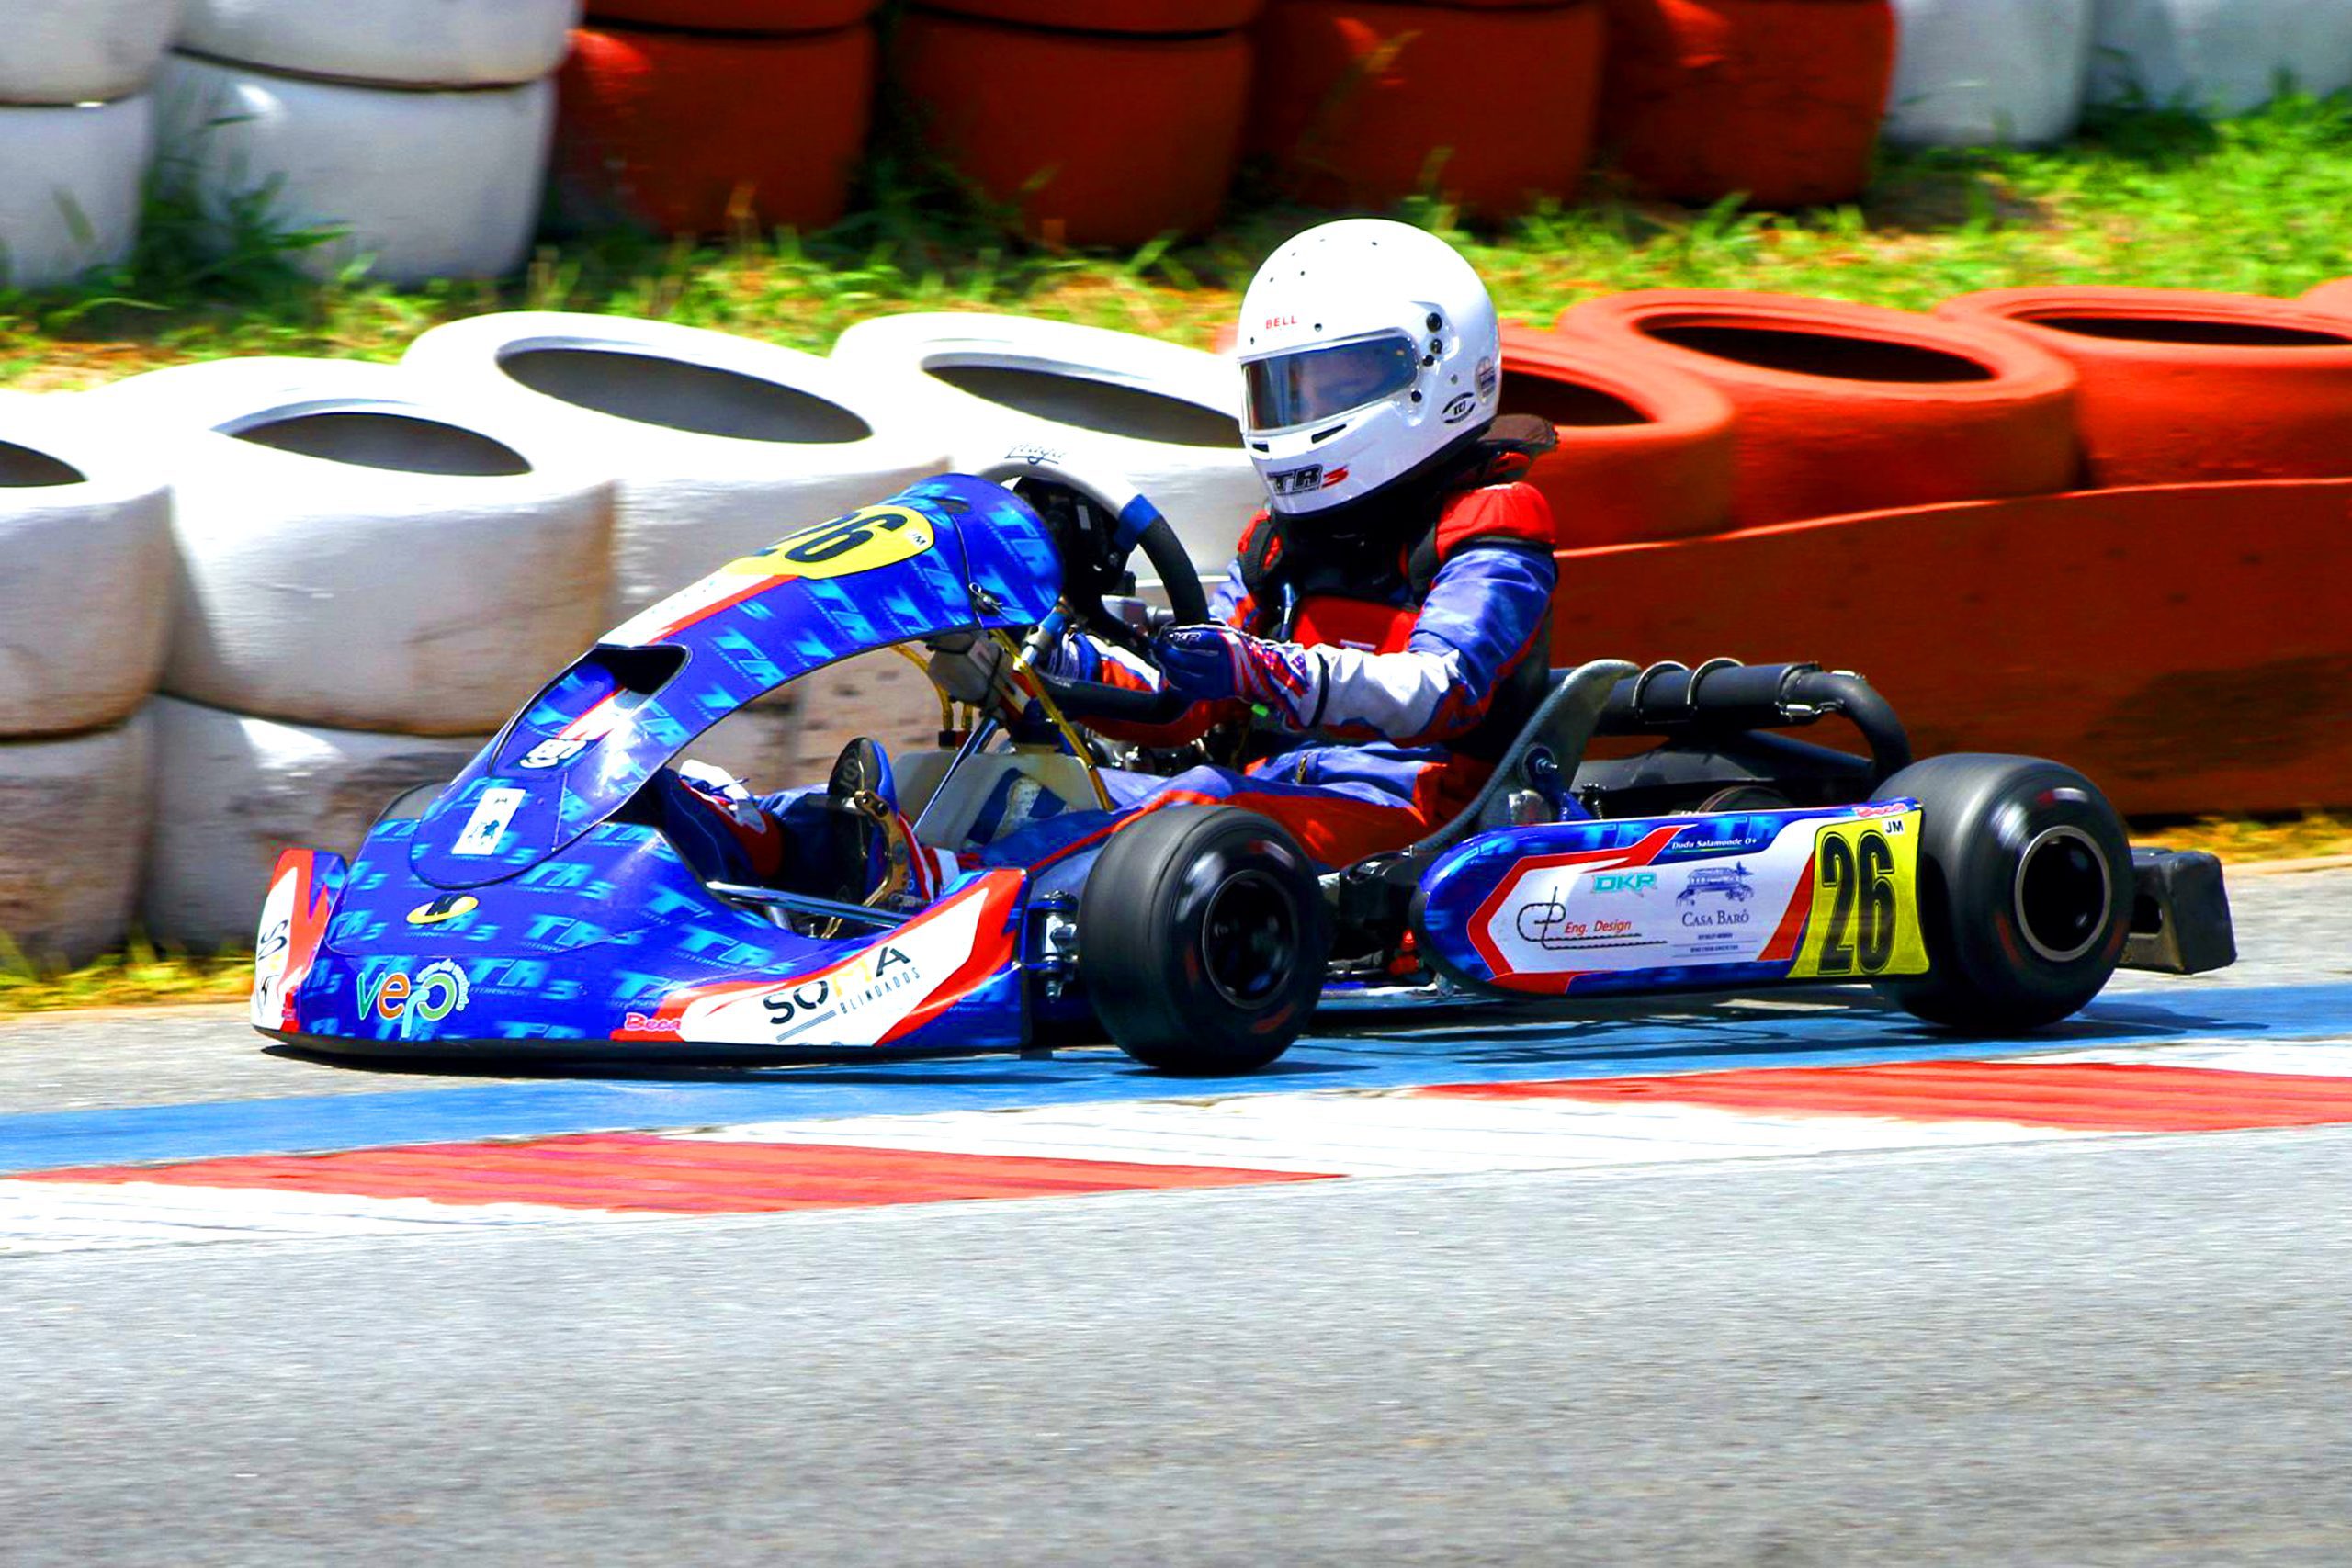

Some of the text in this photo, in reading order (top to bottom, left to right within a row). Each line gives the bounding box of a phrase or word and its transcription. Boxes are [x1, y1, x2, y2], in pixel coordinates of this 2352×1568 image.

[1266, 316, 1298, 329] BELL
[1886, 820, 1904, 834] JM
[1593, 873, 1657, 896] DKR
[1817, 829, 1897, 975] 26
[1565, 919, 1632, 935] Eng. Design
[1682, 911, 1713, 927] CASA
[763, 946, 911, 1024] SOMA
[840, 967, 921, 1014] BLINDADOS
[625, 1012, 681, 1032] Beca
